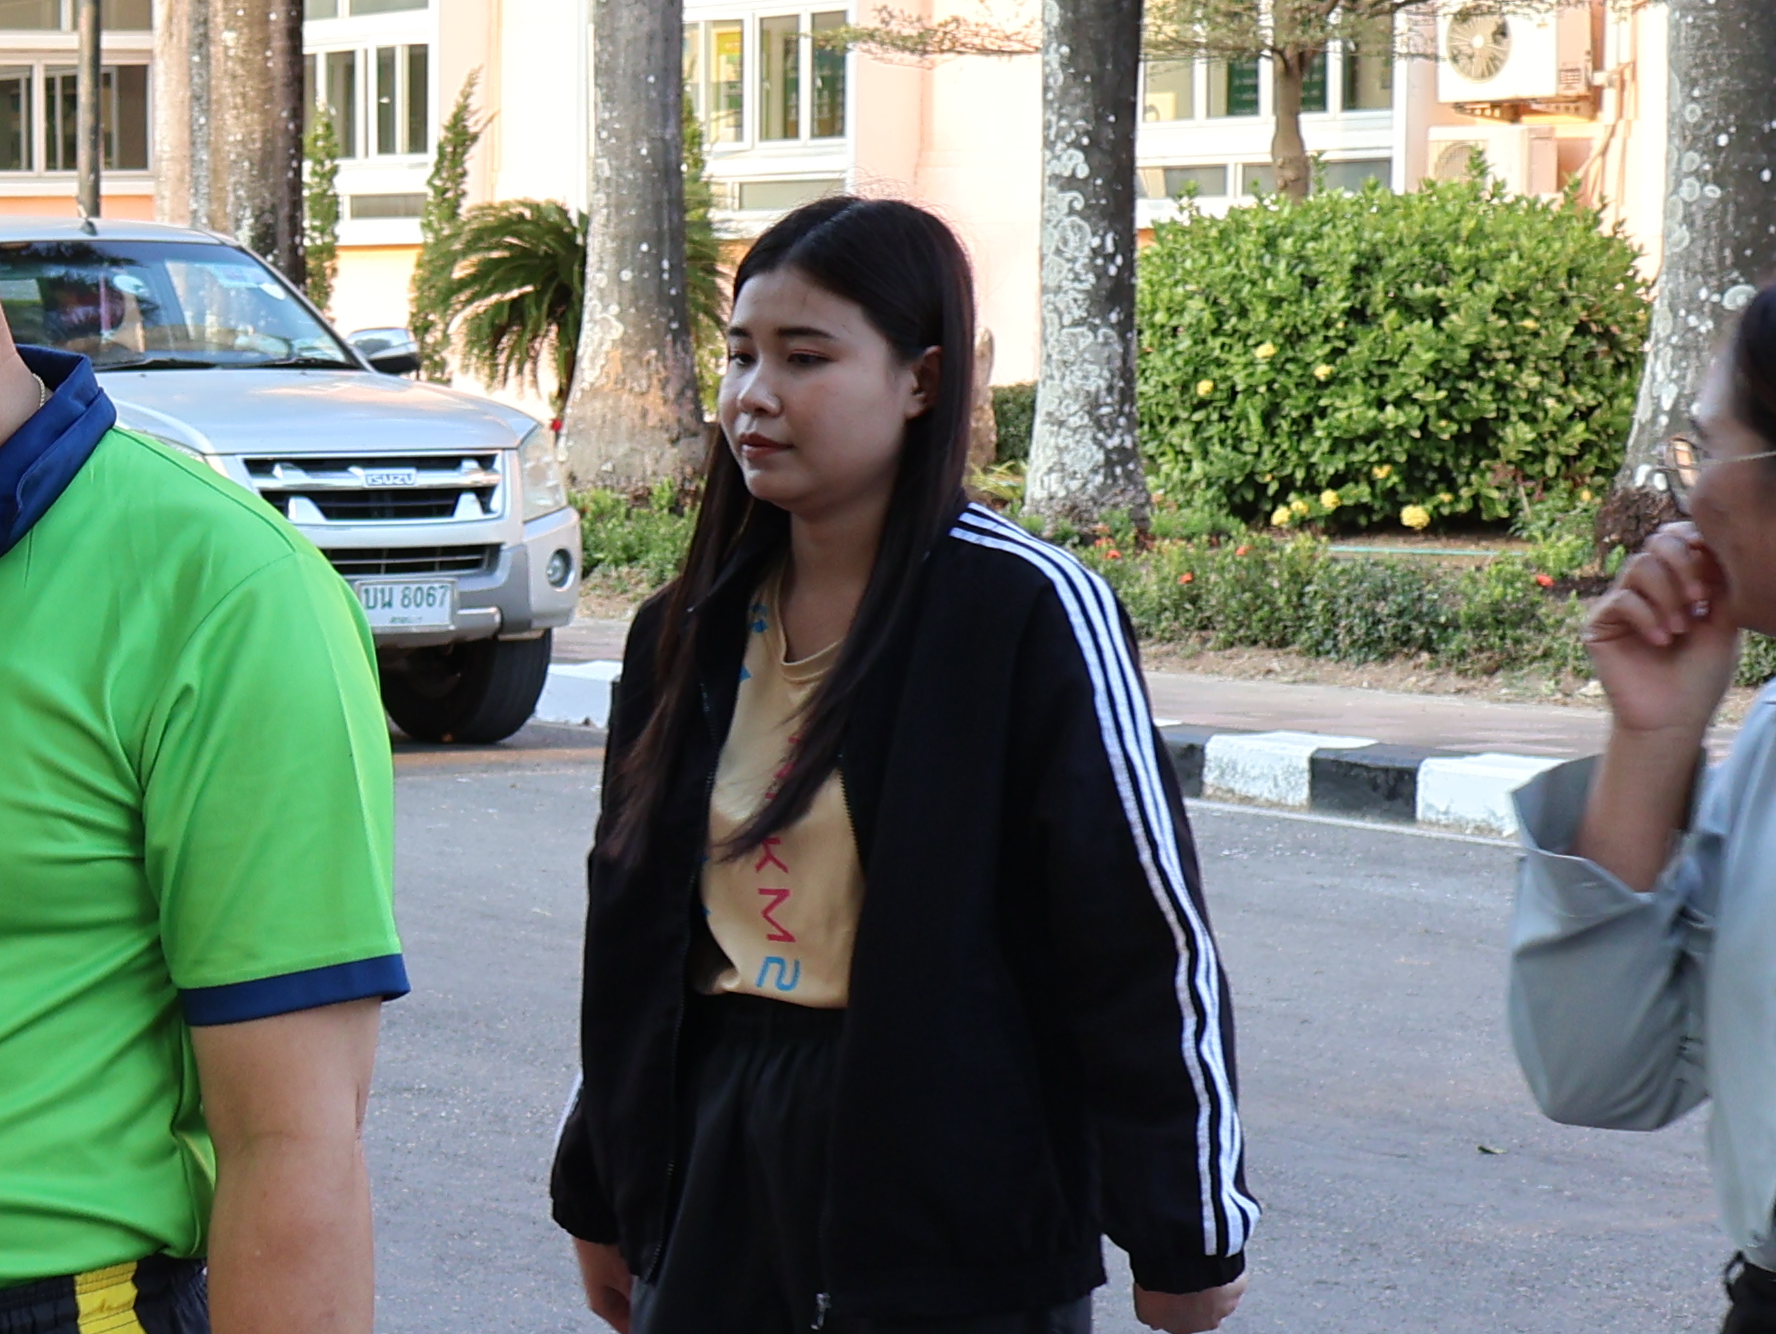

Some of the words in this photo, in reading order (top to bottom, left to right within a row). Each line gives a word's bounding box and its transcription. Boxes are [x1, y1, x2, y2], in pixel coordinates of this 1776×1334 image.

[365, 472, 416, 487] ISUZU
[362, 587, 393, 610] บน
[399, 584, 448, 609] 8067
